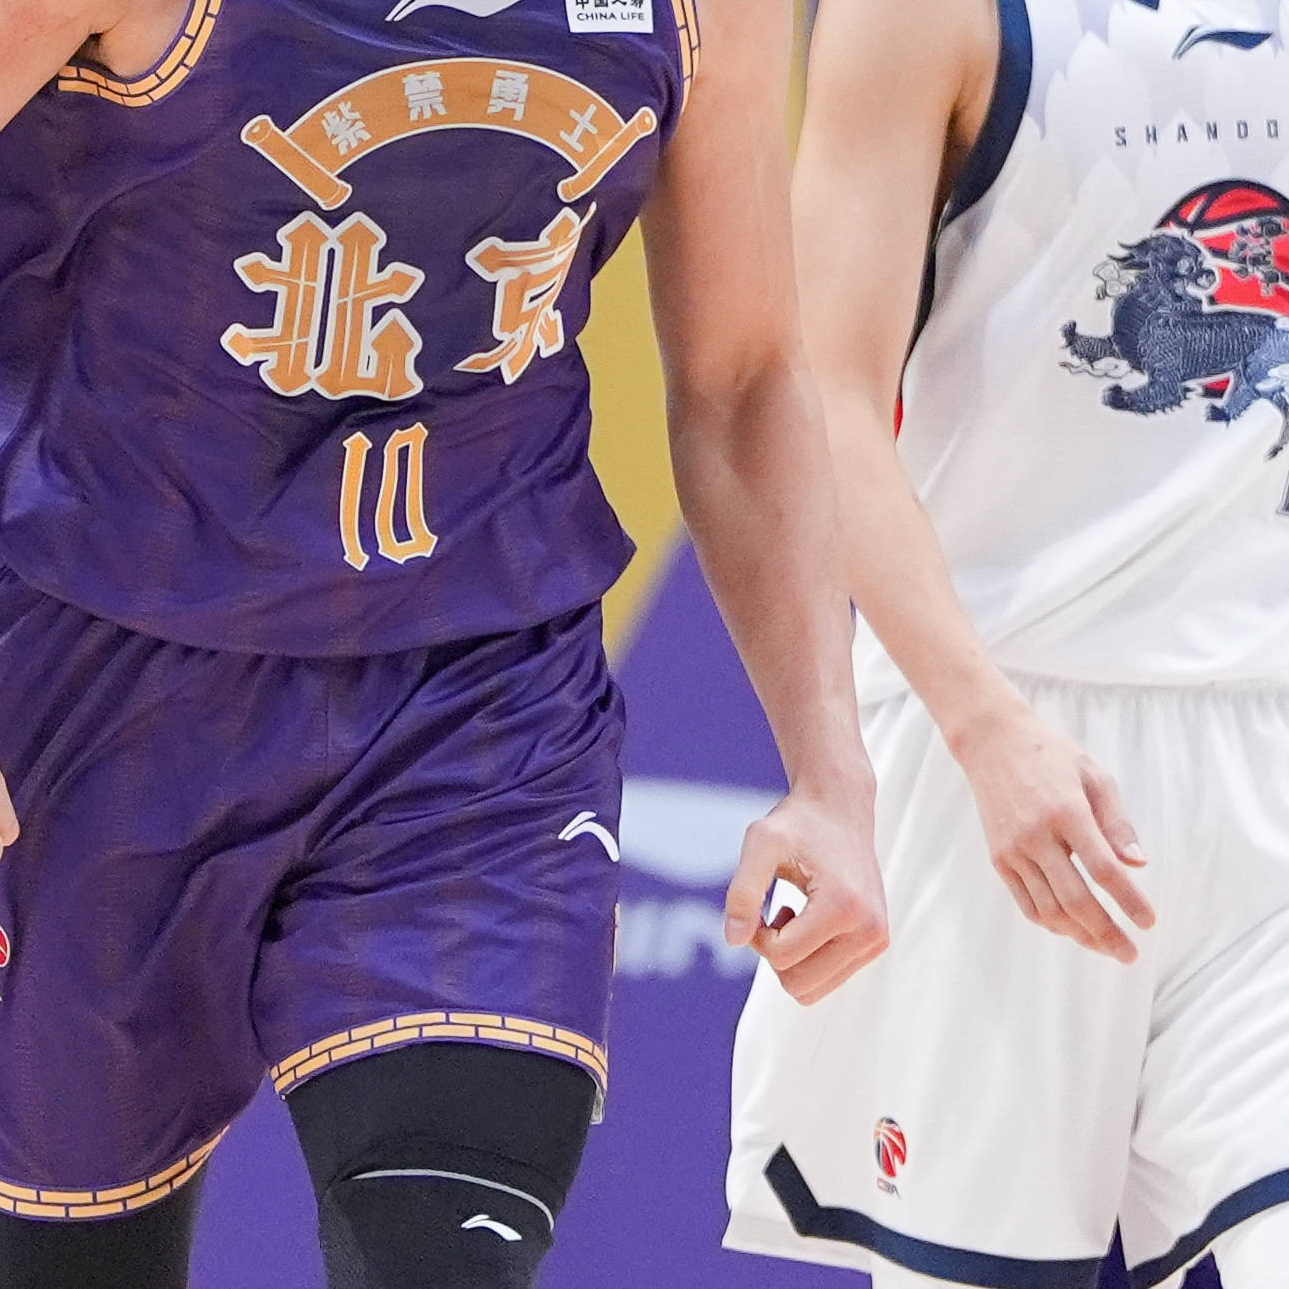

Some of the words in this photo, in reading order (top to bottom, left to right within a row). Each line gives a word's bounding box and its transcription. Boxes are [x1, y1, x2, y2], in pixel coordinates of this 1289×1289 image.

[576, 12, 617, 22] CHINA
[620, 12, 645, 22] LIFE
[321, 69, 599, 157] 紫禁勇士
[220, 201, 598, 400] 北京
[339, 421, 438, 571] 10
